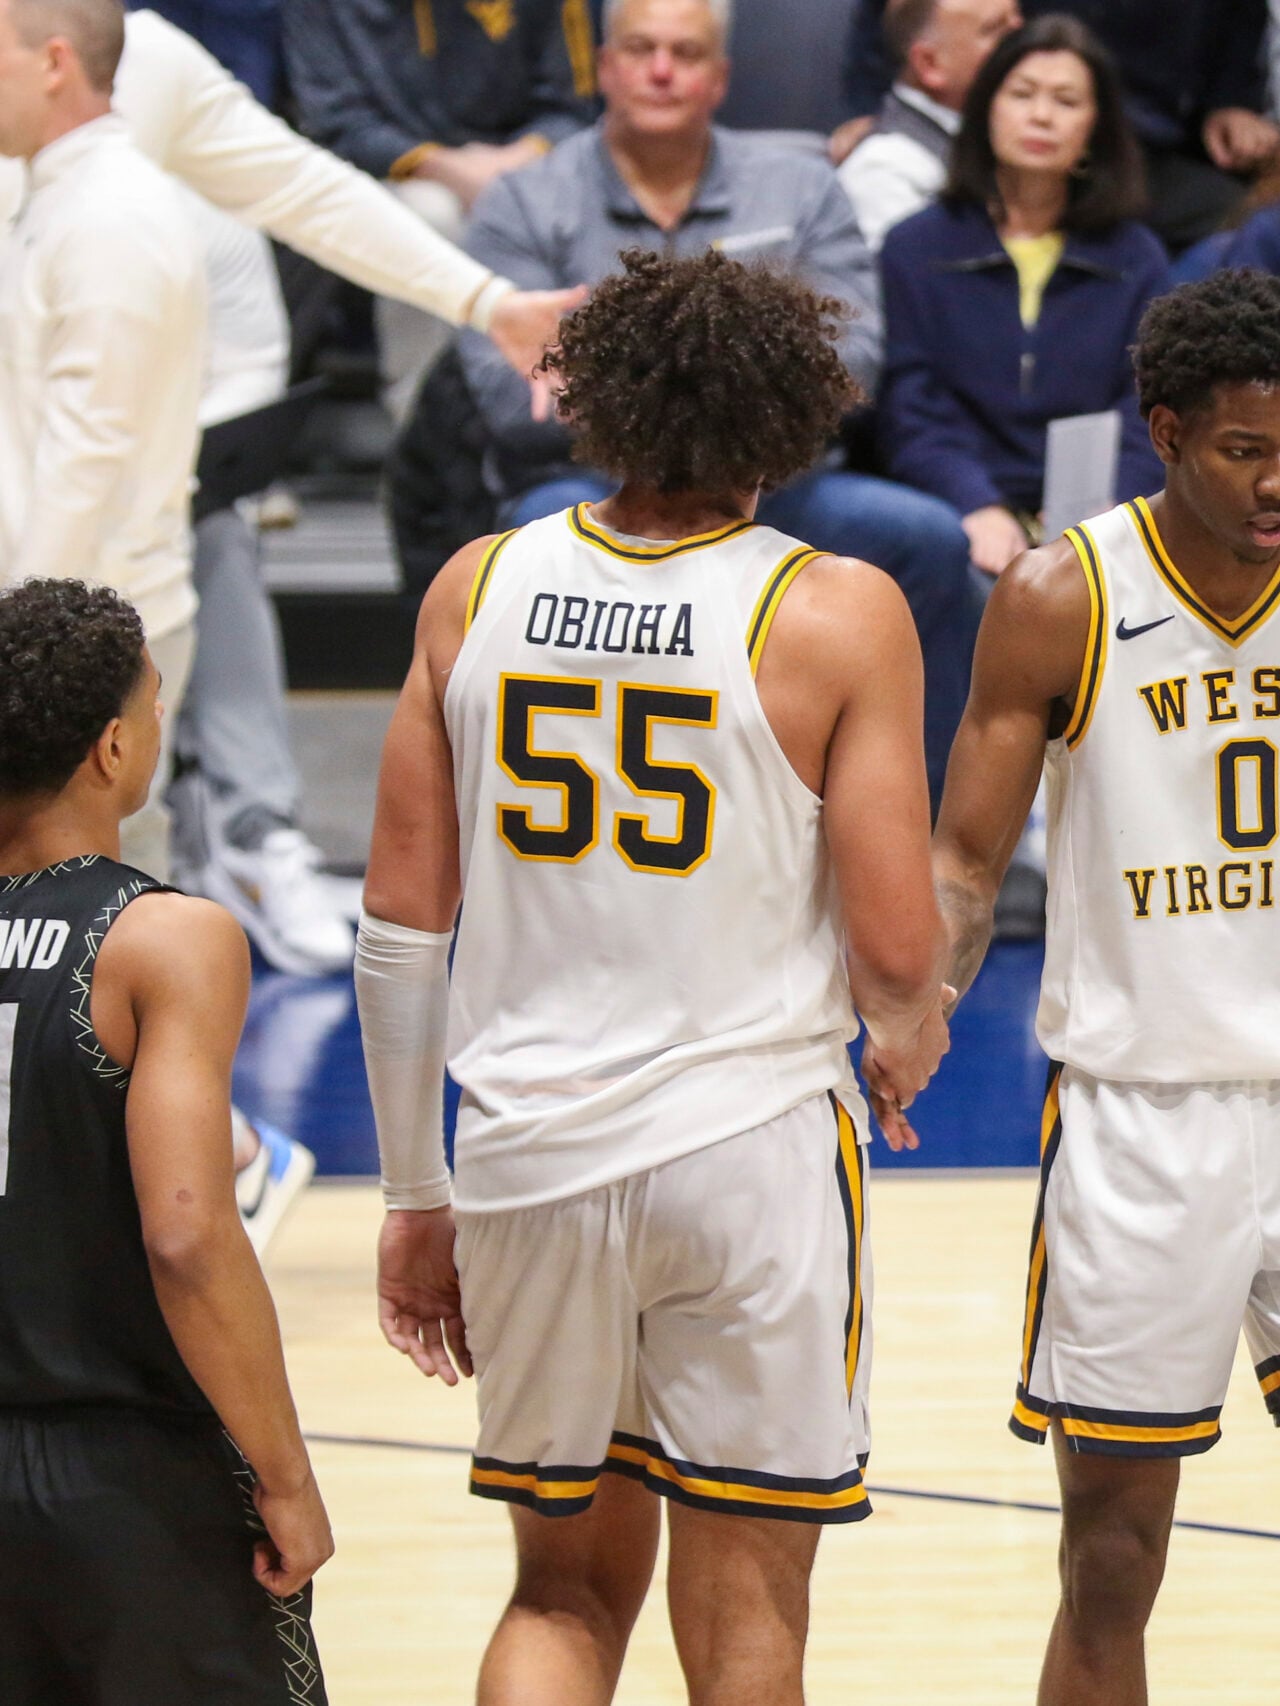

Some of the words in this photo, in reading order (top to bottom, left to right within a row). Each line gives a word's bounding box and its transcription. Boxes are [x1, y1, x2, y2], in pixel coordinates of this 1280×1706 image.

[525, 592, 694, 657] OBIOHA
[496, 672, 719, 877] 55
[1214, 736, 1280, 853] 0
